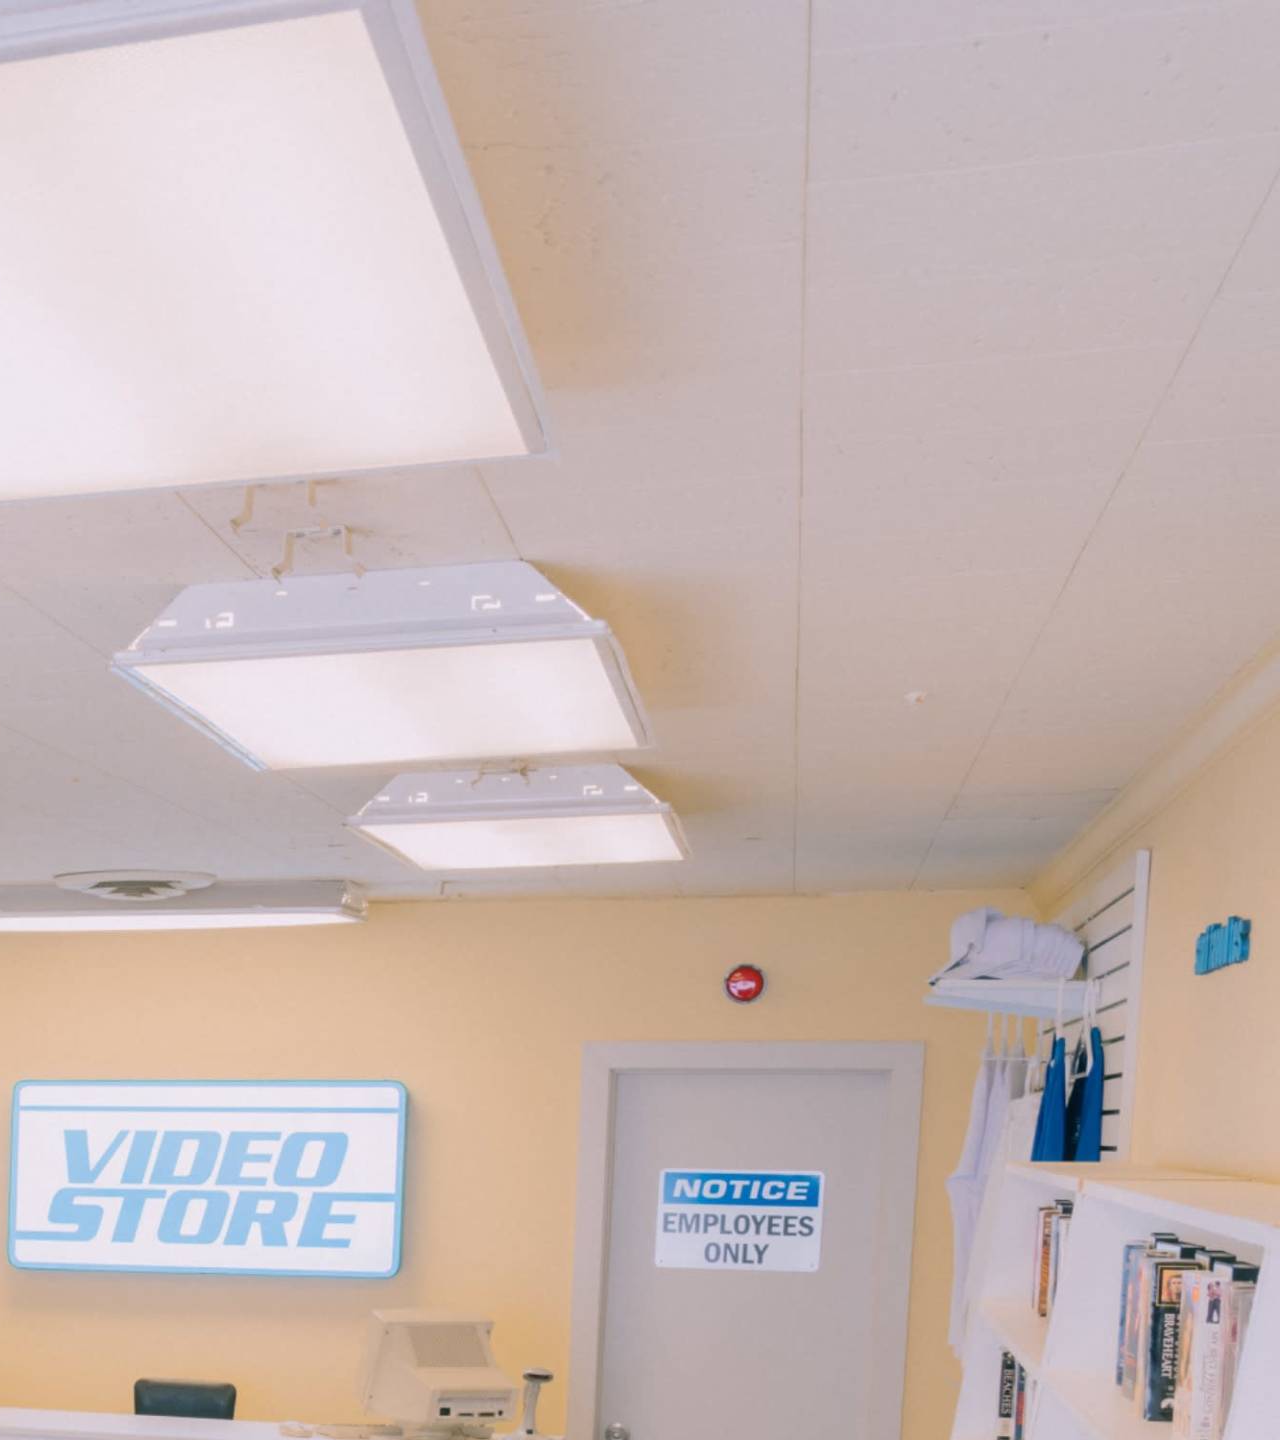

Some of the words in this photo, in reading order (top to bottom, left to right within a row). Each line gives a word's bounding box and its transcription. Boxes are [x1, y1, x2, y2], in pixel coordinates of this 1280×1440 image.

[63, 1129, 349, 1187] VIDEO
[672, 1179, 811, 1200] NOTICE
[47, 1187, 357, 1249] STORE
[662, 1212, 814, 1237] EMPLOYEES
[704, 1242, 769, 1264] ONLY
[1162, 1313, 1175, 1379] BRAVEHEART
[1001, 1369, 1014, 1414] BEACHES
